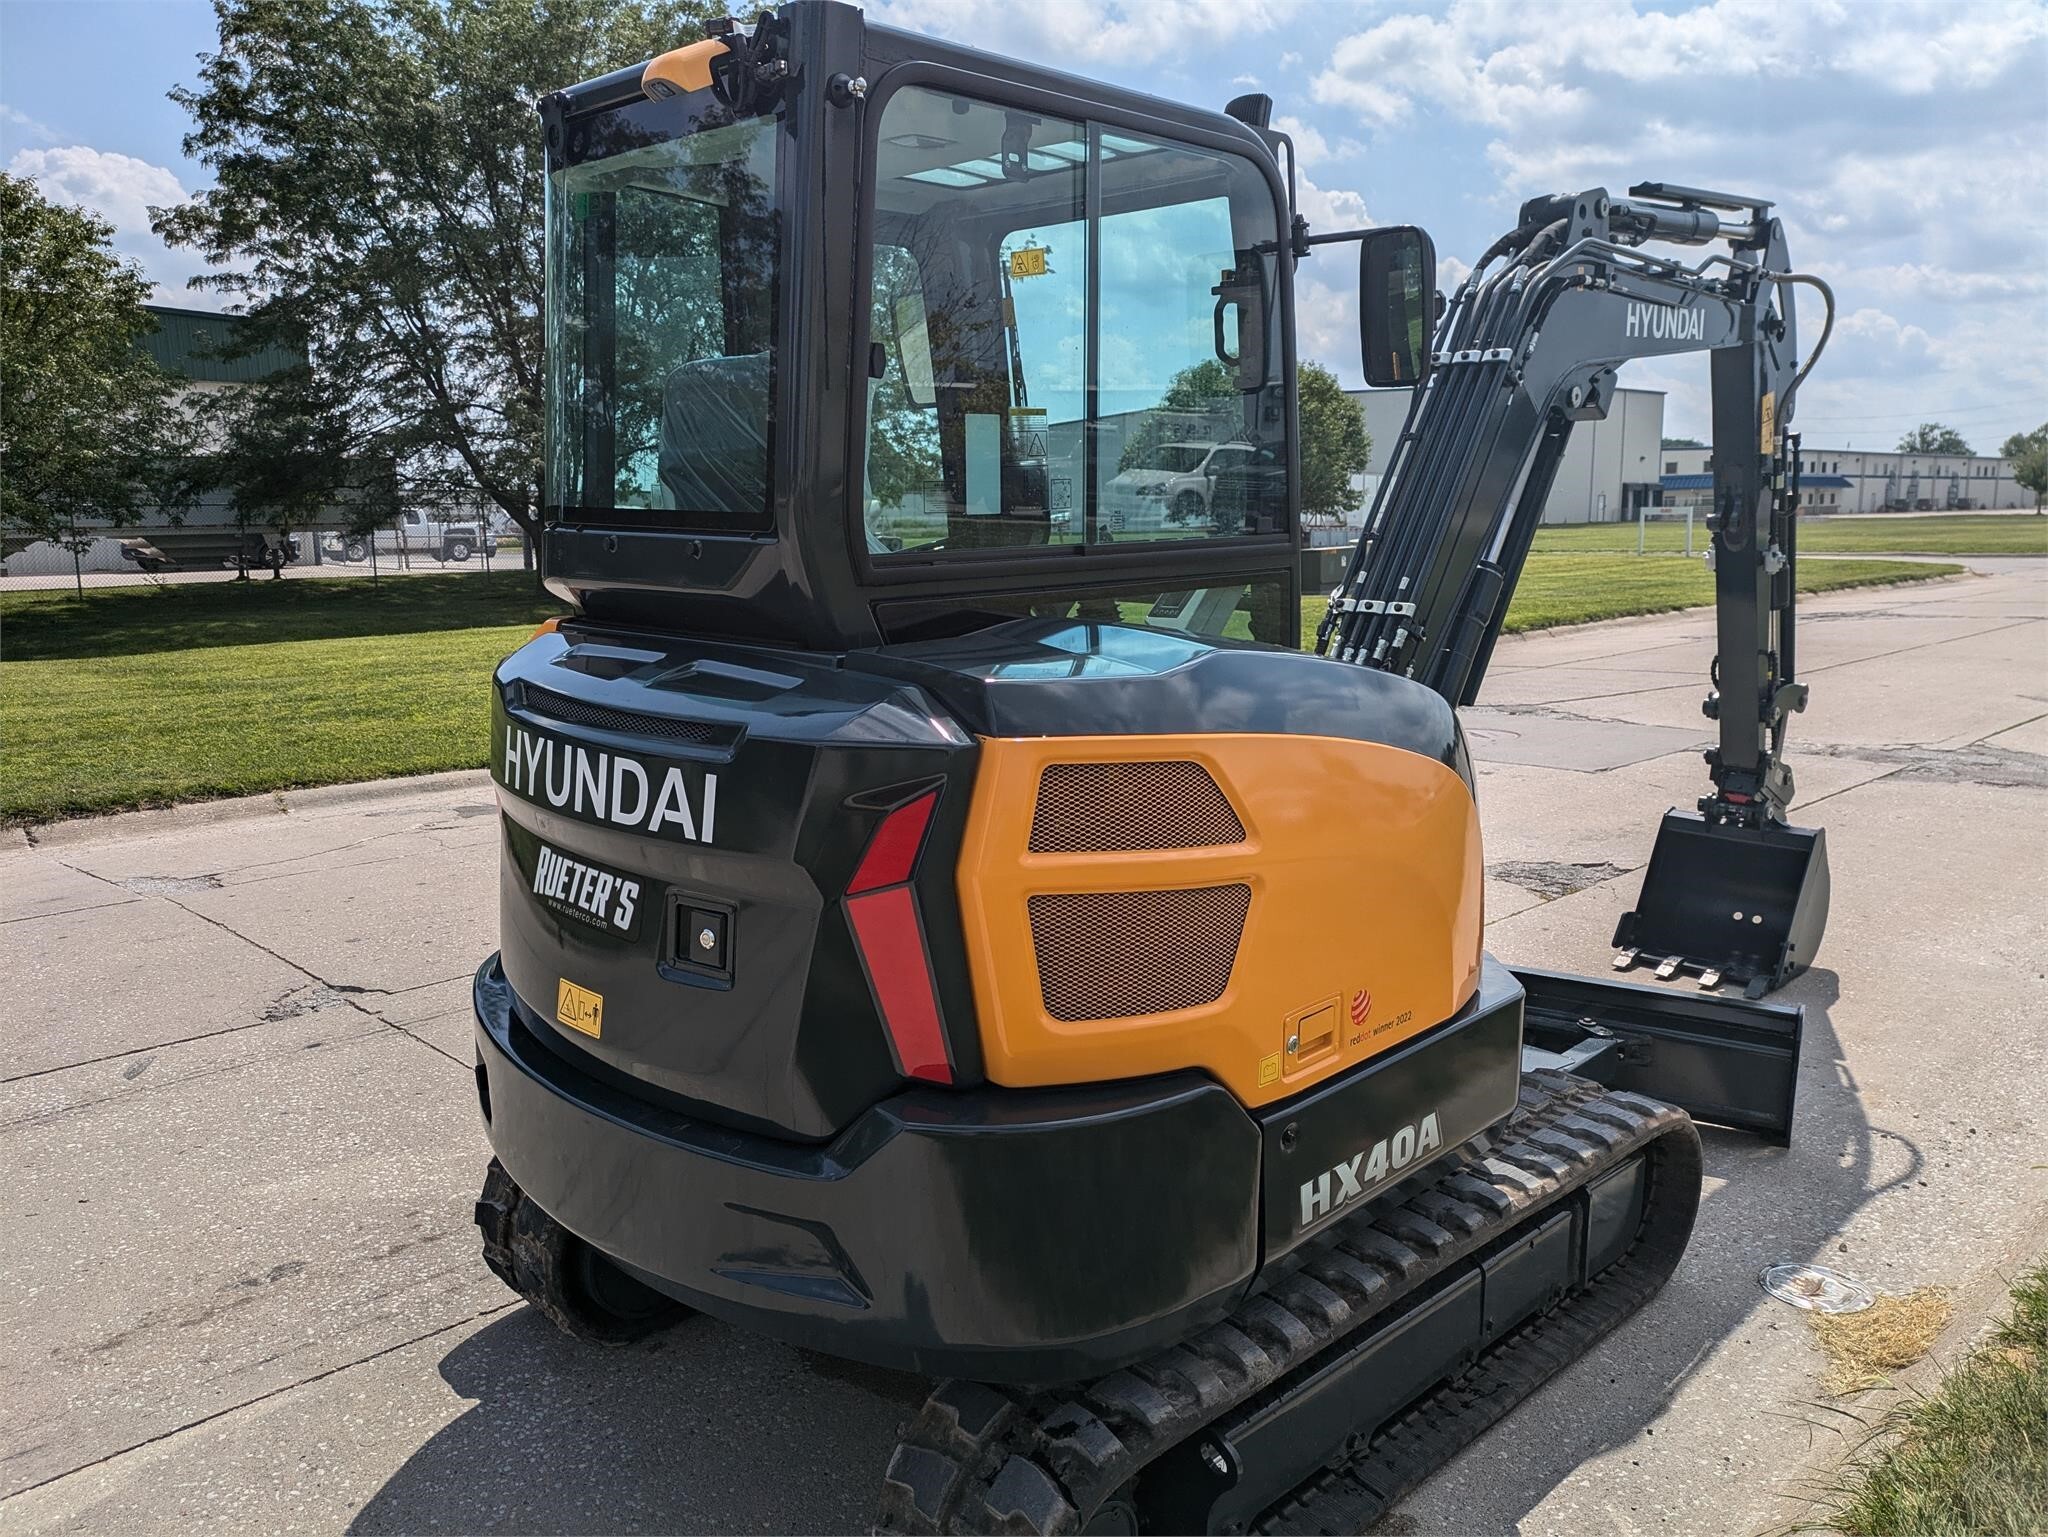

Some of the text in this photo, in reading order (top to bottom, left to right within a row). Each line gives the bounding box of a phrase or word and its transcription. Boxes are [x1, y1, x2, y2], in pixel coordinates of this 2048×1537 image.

[1627, 302, 1705, 340] HYUNDAI
[504, 725, 717, 844] HYUNDAI
[533, 845, 640, 931] RUETER'S
[548, 899, 608, 930] www.rueterco.com
[1373, 1020, 1395, 1036] winner
[1396, 1010, 1412, 1026] 2022
[1300, 1112, 1441, 1226] HX40A
